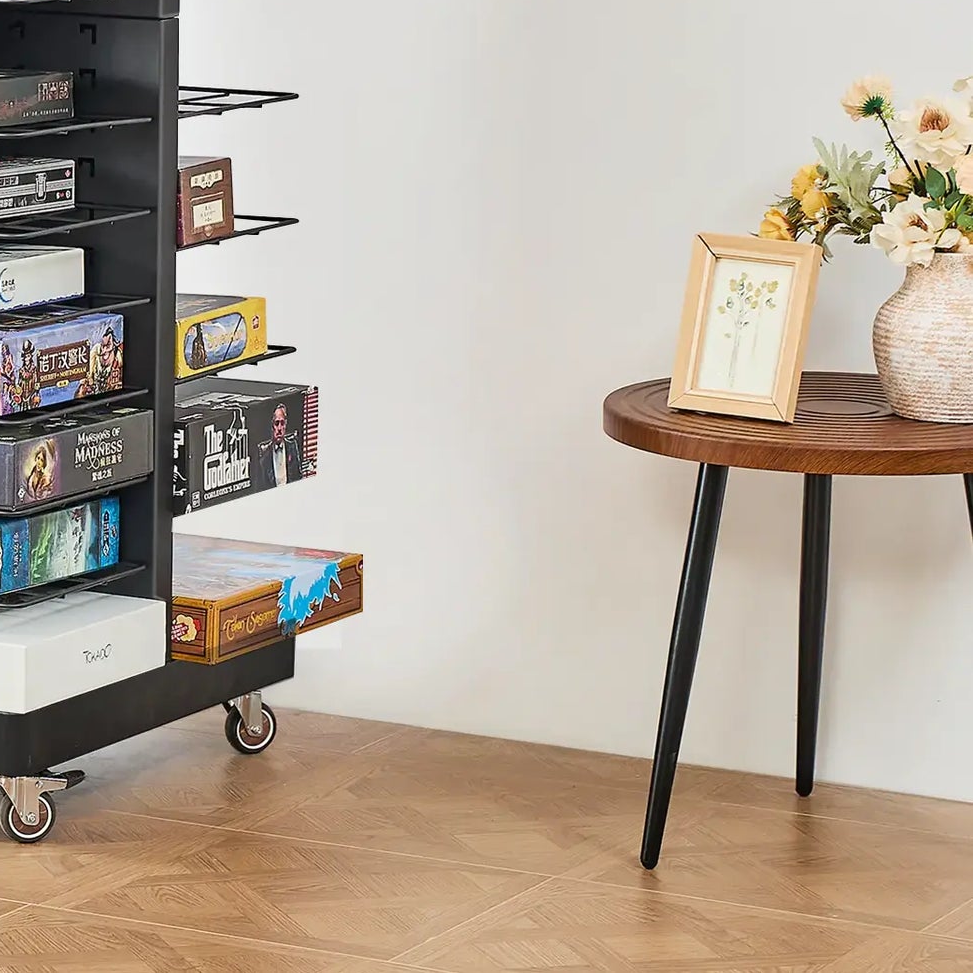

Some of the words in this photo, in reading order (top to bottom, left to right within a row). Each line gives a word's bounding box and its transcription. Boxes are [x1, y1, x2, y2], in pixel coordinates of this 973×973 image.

[39, 346, 88, 373] 诺丁汉警长
[111, 427, 121, 437] OF
[203, 424, 224, 457] The
[74, 439, 123, 464] MADNESS
[203, 449, 251, 492] Godfather
